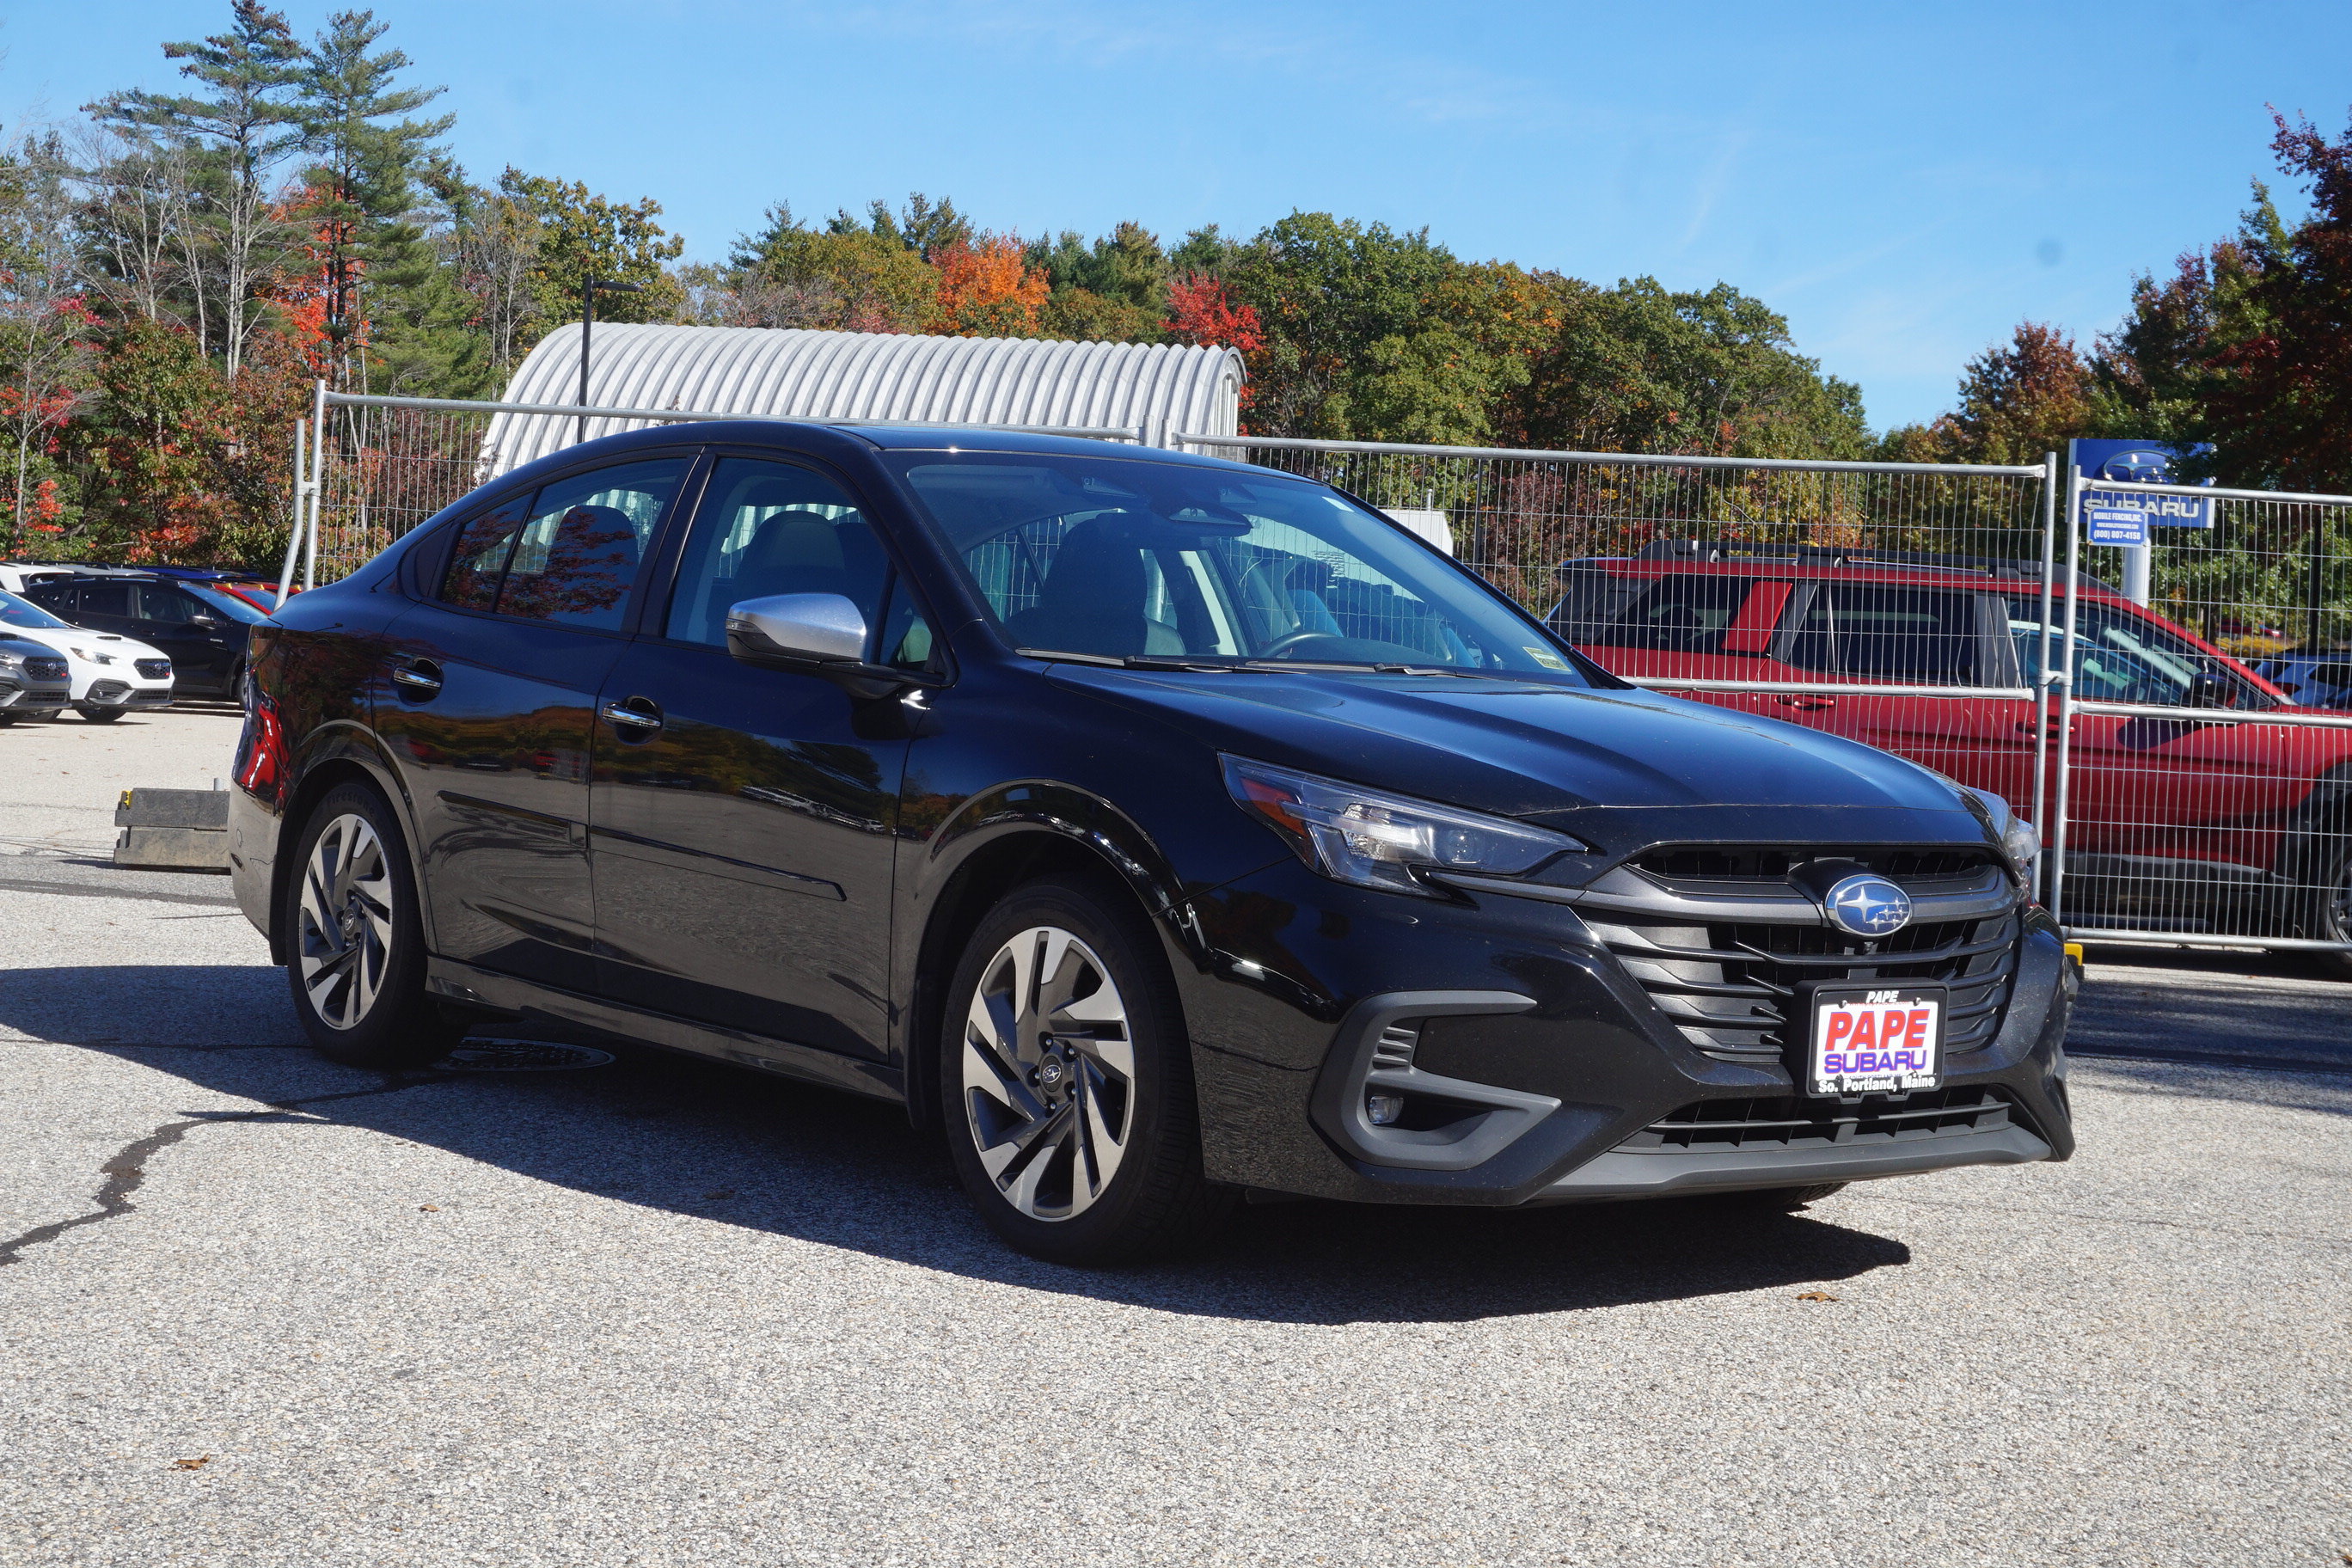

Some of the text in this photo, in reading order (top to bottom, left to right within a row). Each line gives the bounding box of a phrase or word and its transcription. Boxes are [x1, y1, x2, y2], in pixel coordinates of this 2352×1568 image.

[2093, 530, 2141, 540] (800) 807-4158
[1865, 990, 1899, 1003] PAPE
[1824, 1008, 1930, 1051] PAPE
[1824, 1050, 1926, 1074] SUBARU
[1818, 1075, 1935, 1093] So. Portland, Maine
